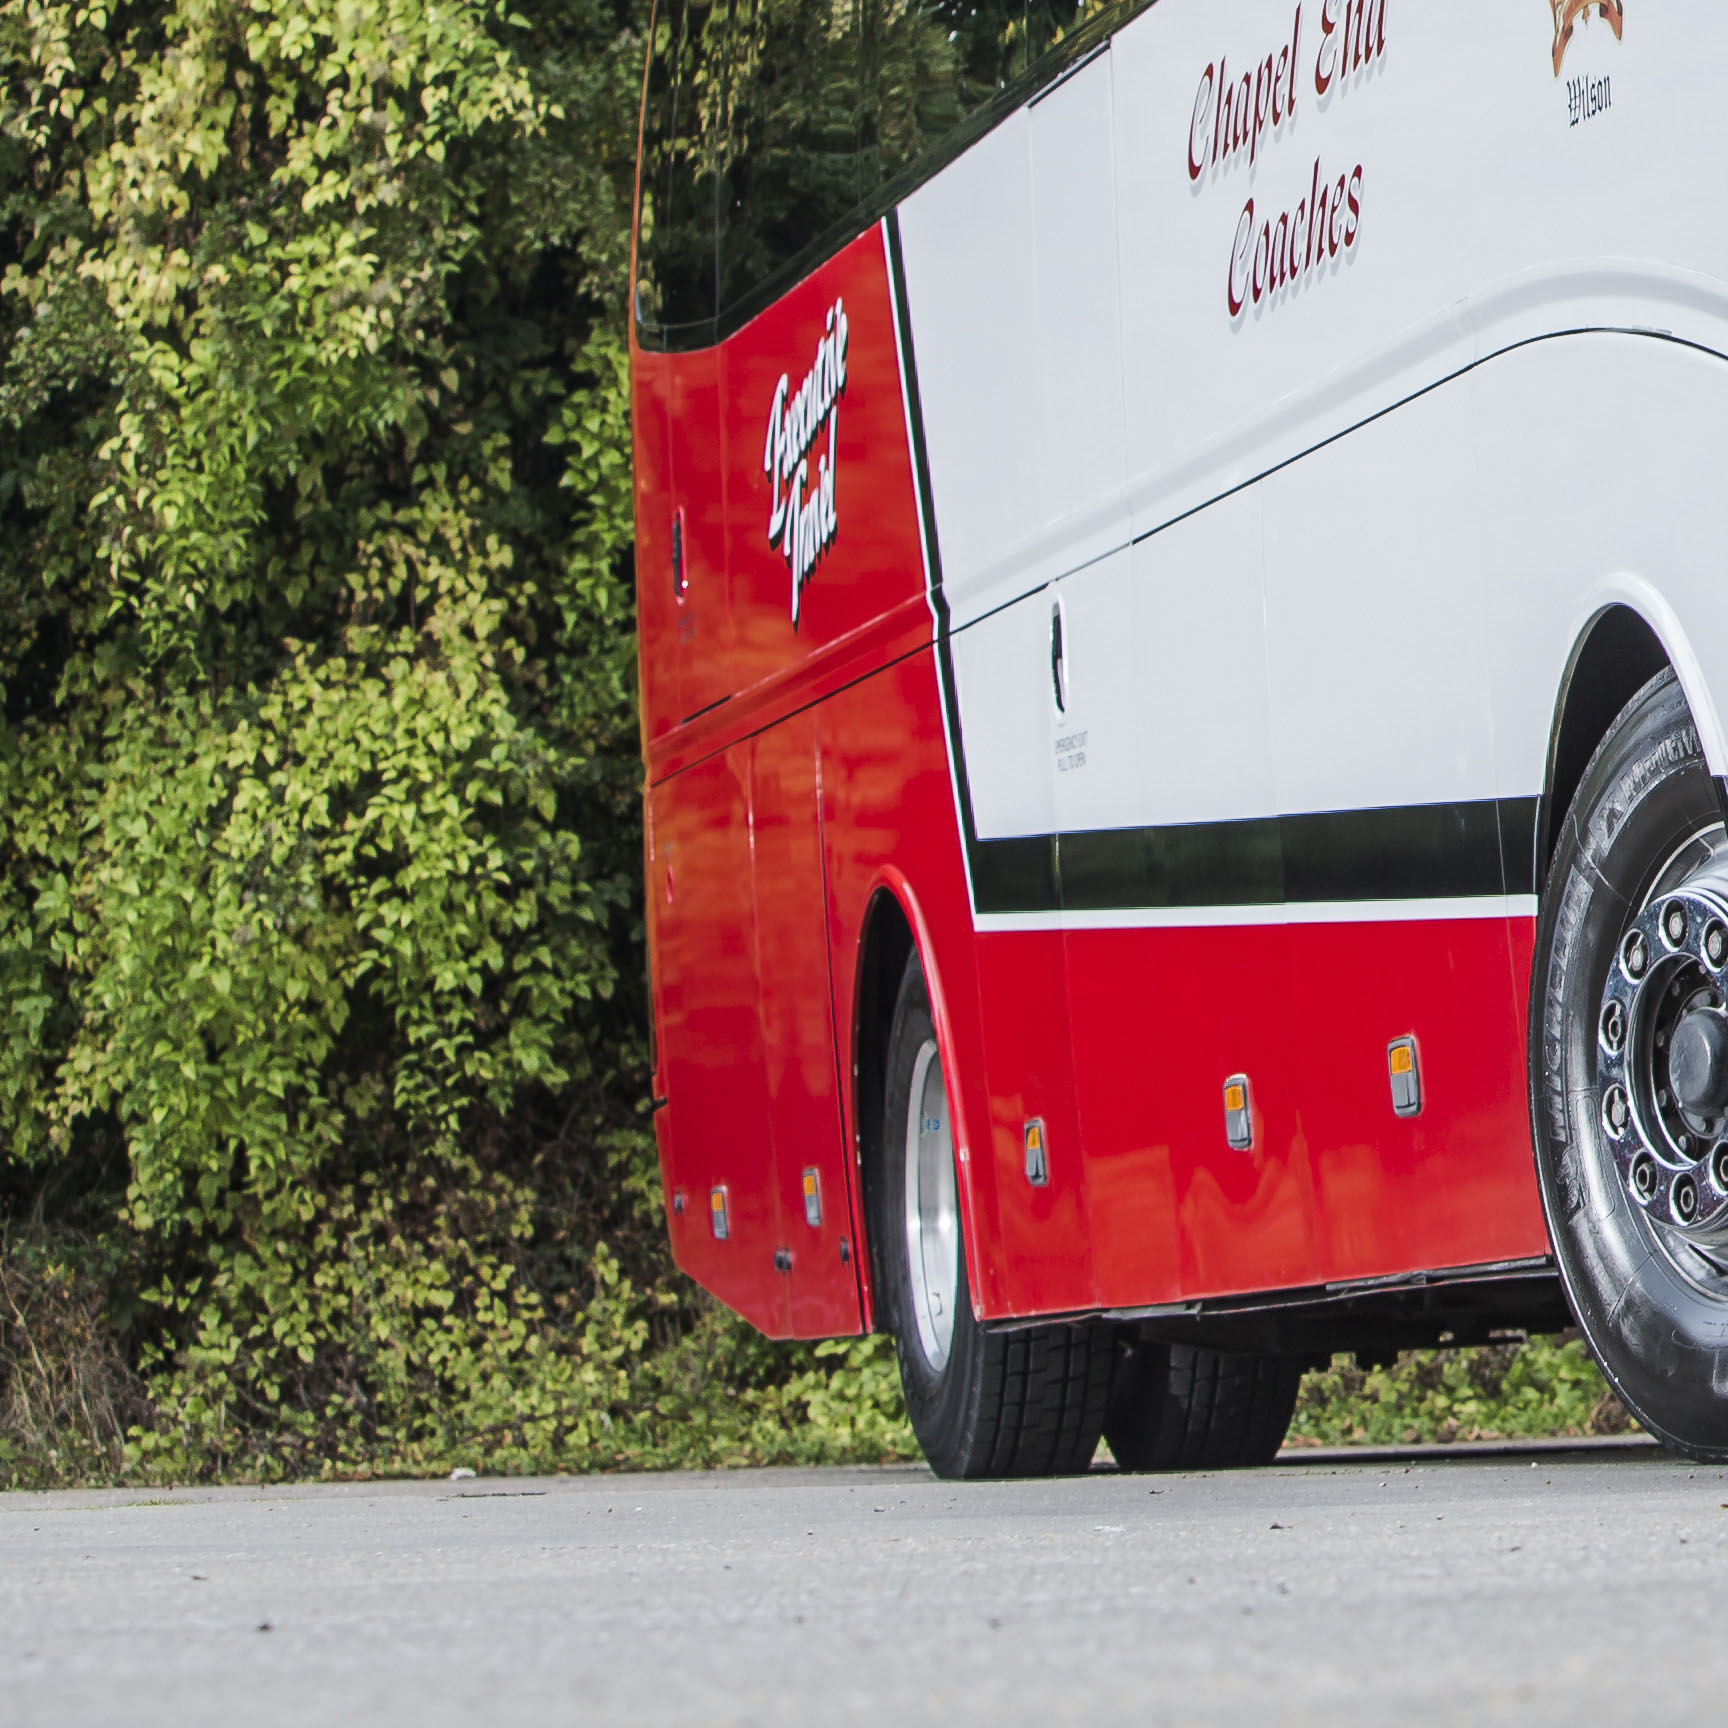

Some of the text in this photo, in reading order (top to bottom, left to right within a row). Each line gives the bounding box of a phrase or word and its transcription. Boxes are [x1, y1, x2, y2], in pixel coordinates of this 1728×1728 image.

[1187, 0, 1303, 181] Chapel
[1566, 74, 1612, 129] Wilson
[1228, 156, 1364, 319] Coaches
